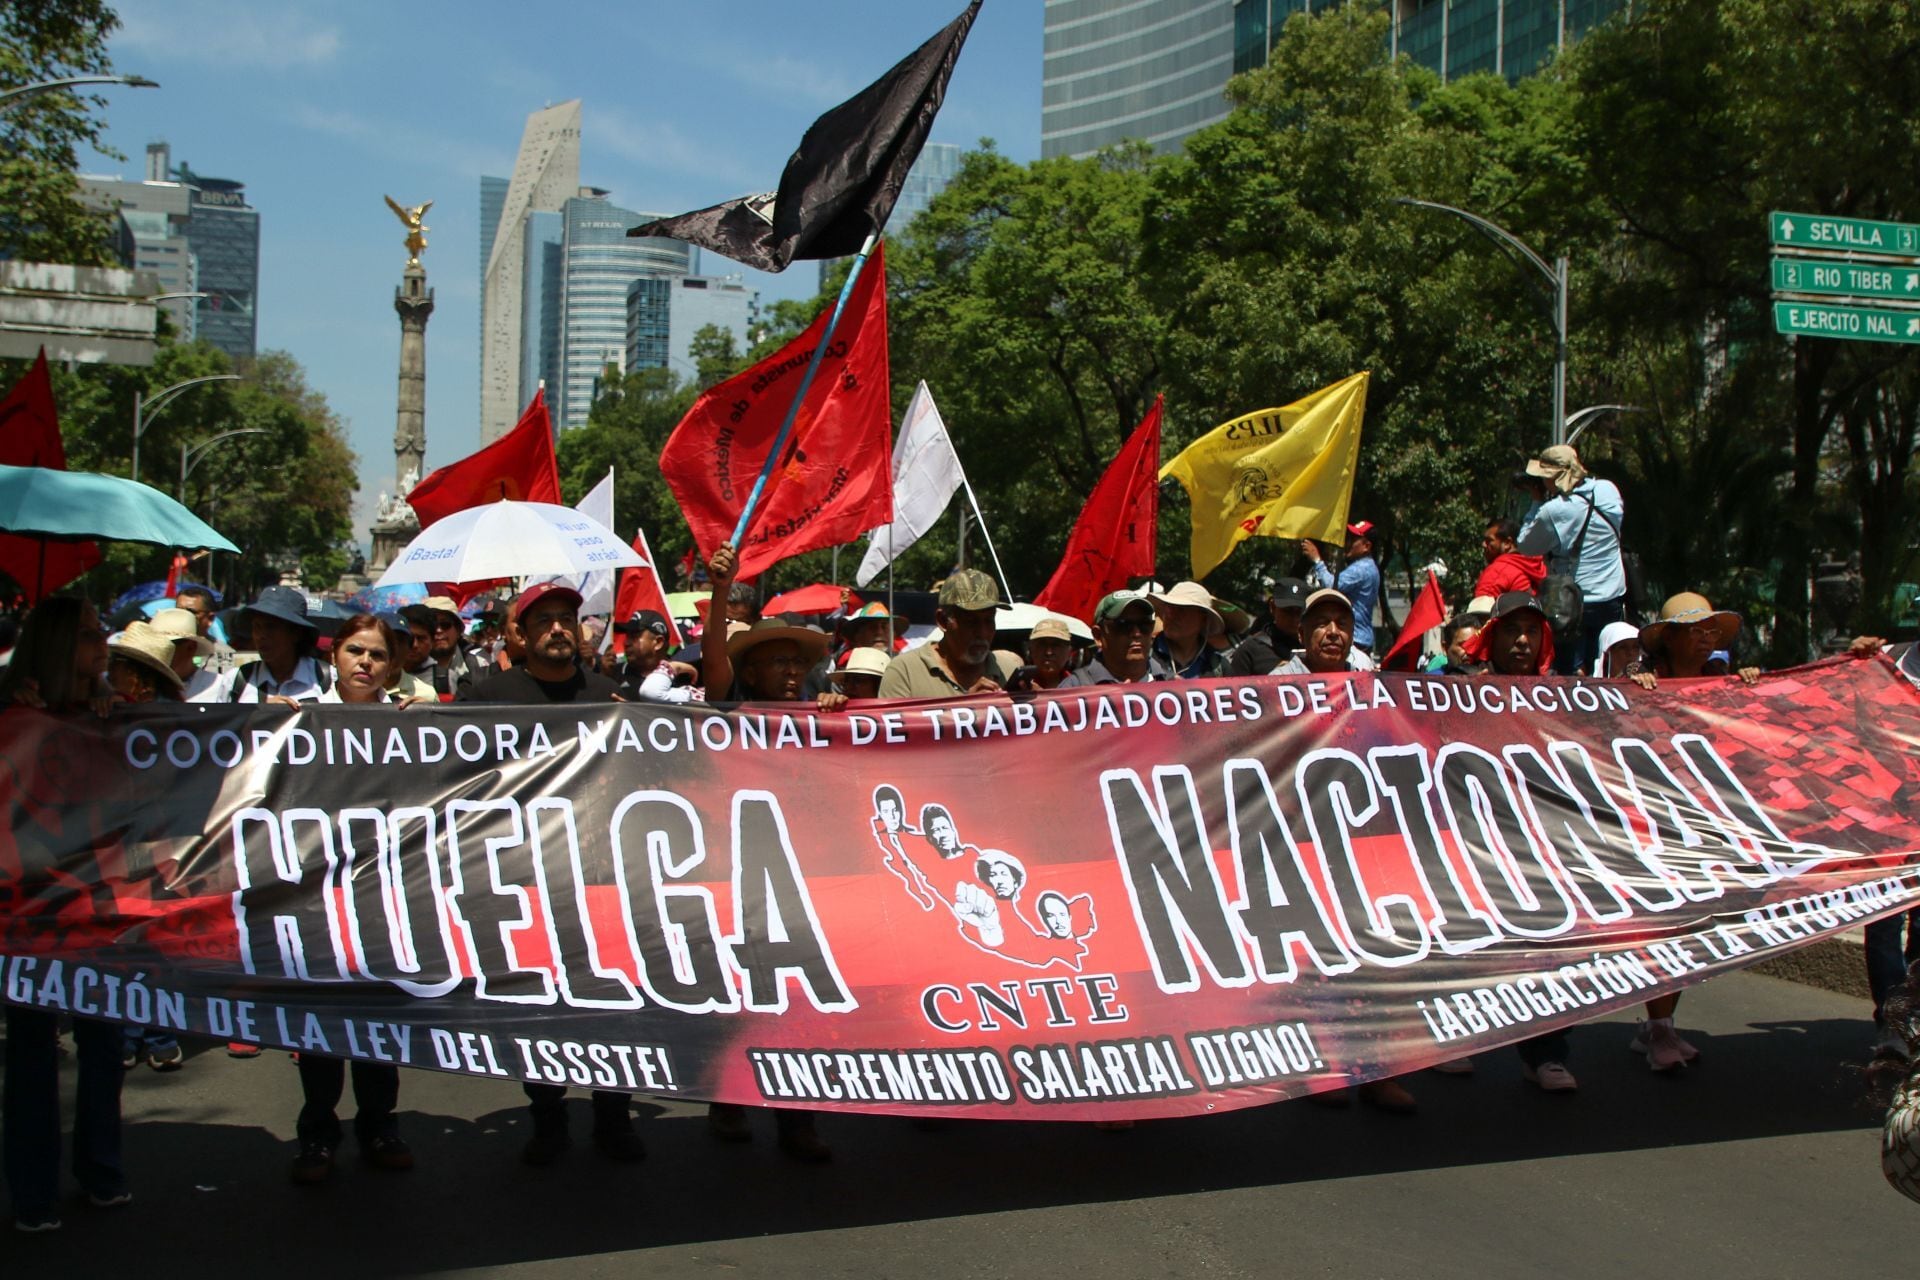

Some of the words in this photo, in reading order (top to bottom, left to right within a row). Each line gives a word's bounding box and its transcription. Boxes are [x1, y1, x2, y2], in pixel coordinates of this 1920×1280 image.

[201, 190, 243, 205] BBVA
[1810, 222, 1883, 246] SEVILLA
[1903, 232, 1912, 247] 3
[1787, 267, 1797, 284] 2
[1814, 268, 1841, 288] RIO
[1848, 270, 1893, 290] TIBER
[1789, 309, 1860, 332] EJERCITO
[1867, 316, 1897, 335] NAL
[404, 545, 460, 564] ¡Basta!
[574, 536, 604, 548] paso
[125, 722, 556, 769] COORDINADORA
[577, 715, 830, 754] NACIONAL
[852, 714, 907, 747] DE
[929, 686, 1264, 741] TRABAJADORES
[1281, 682, 1332, 716] DE
[1352, 681, 1398, 712] LA
[1409, 677, 1631, 714] EDUCACIÓN
[1100, 734, 1850, 994] NACIONAL
[232, 789, 859, 1015] HUELGA
[1416, 952, 1657, 1044] ¡ABROGACIÓN
[1647, 940, 1708, 978] DE
[1694, 924, 1755, 961] LA
[1744, 876, 1914, 947] REFORMA
[0, 953, 188, 1031] GACIÓN
[207, 996, 261, 1042] DE
[276, 1006, 333, 1053] LA
[344, 1018, 412, 1064] LEY
[431, 1028, 506, 1076] DEL
[515, 1037, 678, 1092] ISSSTE!
[920, 974, 1131, 1034] CNTE
[754, 1048, 1010, 1101] ¡INCREMENTO
[1016, 1041, 1192, 1099] SALARIAL
[1198, 1025, 1324, 1083] DIGNO!
